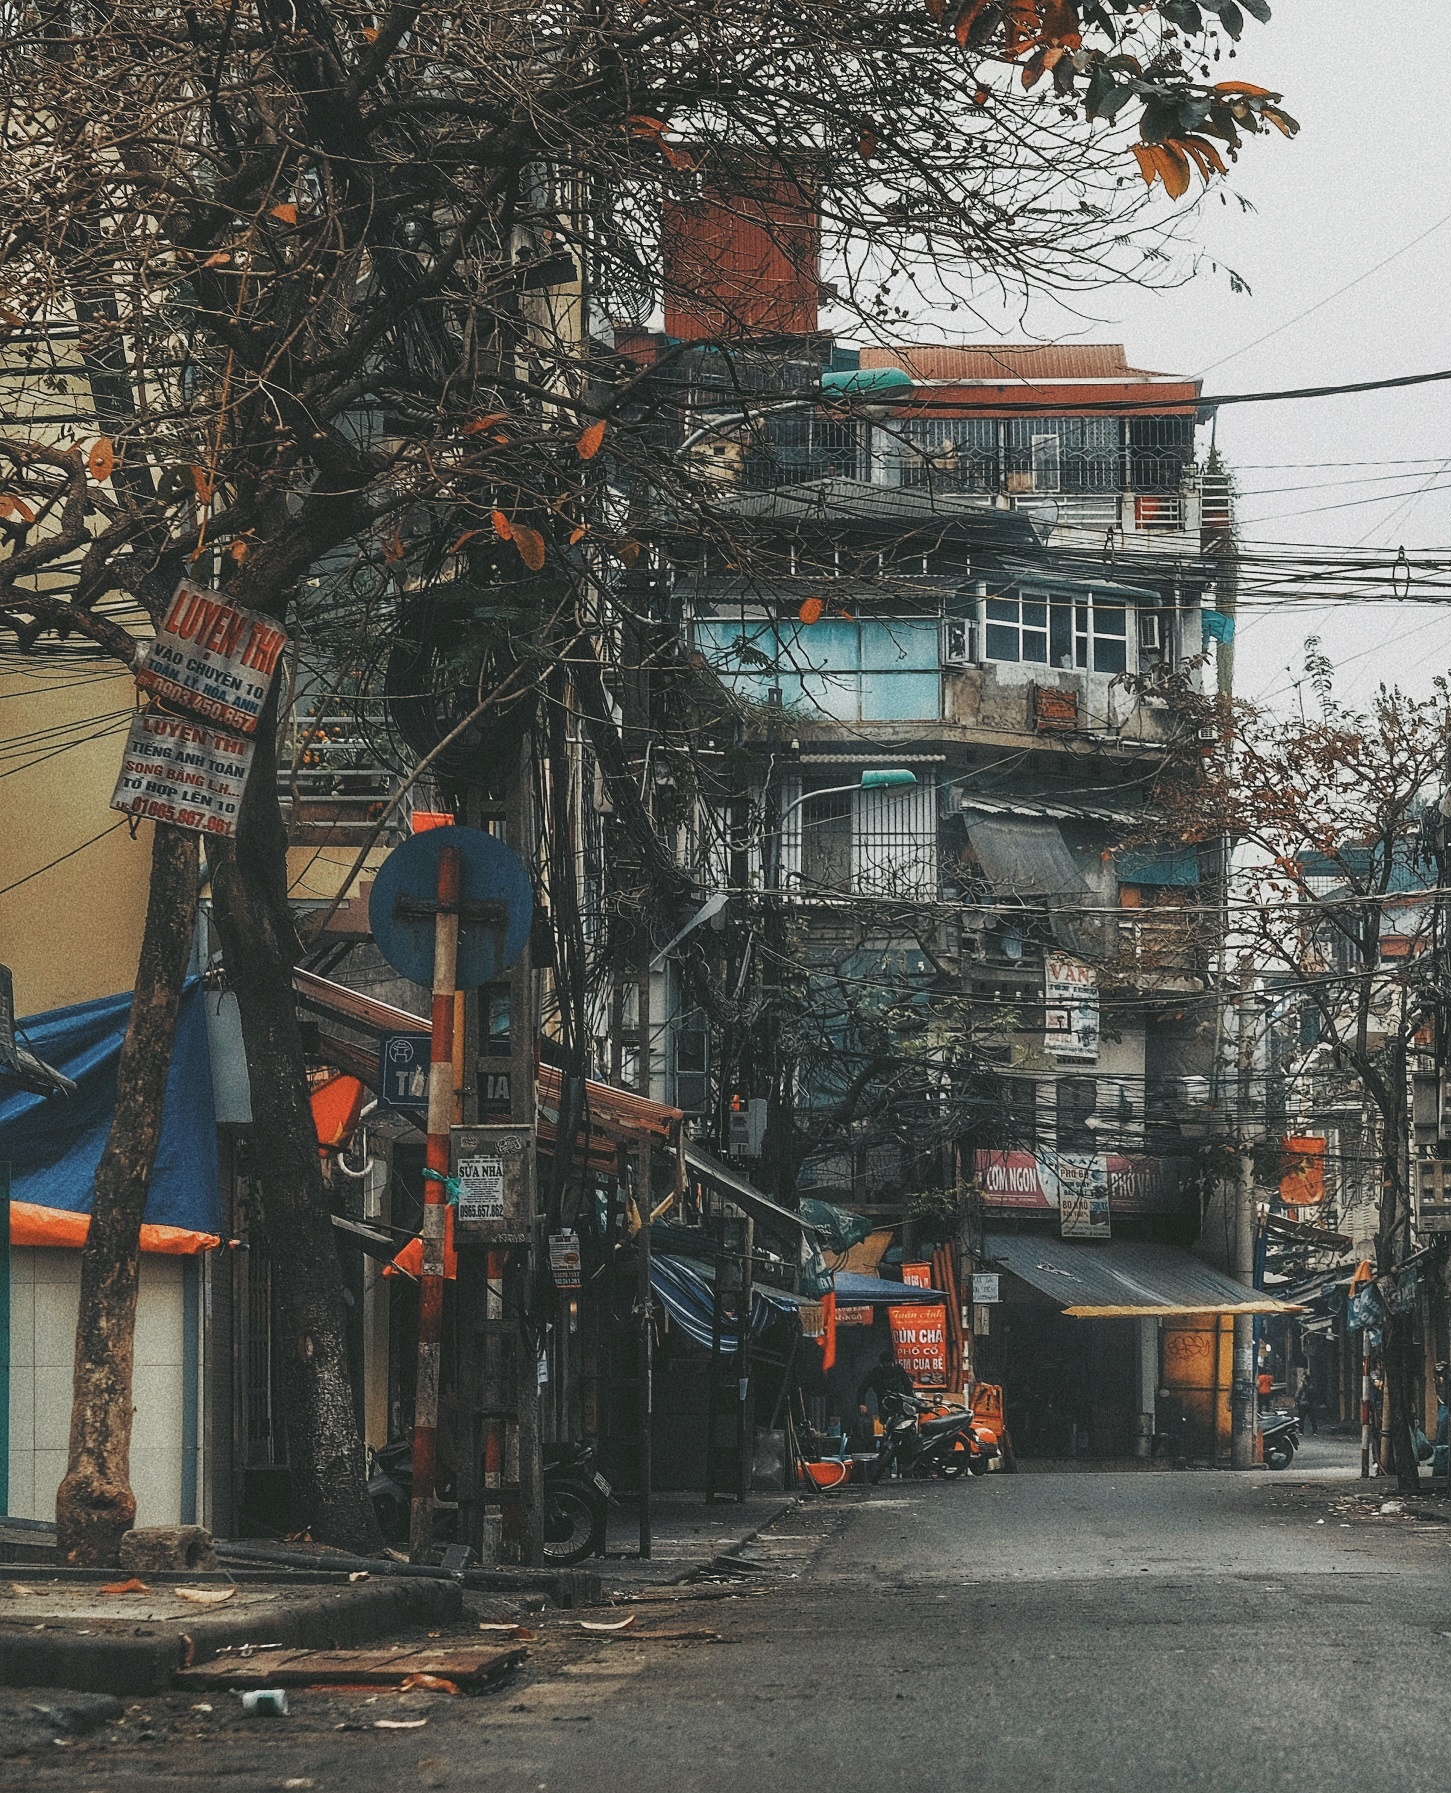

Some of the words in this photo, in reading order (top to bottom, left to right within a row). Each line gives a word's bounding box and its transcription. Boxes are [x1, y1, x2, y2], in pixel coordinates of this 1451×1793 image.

[240, 621, 287, 675] THI
[154, 643, 183, 665] VÀO
[186, 658, 243, 691] CHUYÊN
[247, 683, 264, 699] 10
[154, 677, 255, 733] 0903.450.857
[232, 694, 260, 714] ANH
[213, 734, 246, 755] THI
[126, 760, 163, 776] SONG
[132, 740, 173, 758] TIẾNG
[175, 751, 205, 767] ANH
[209, 759, 245, 778] TOÁN
[181, 789, 213, 807] LÊN
[217, 801, 235, 814] 10
[481, 1163, 503, 1177] NHÀ
[1009, 1167, 1037, 1192] NGON
[920, 1323, 943, 1343] CHẢ
[913, 1358, 931, 1370] CUA
